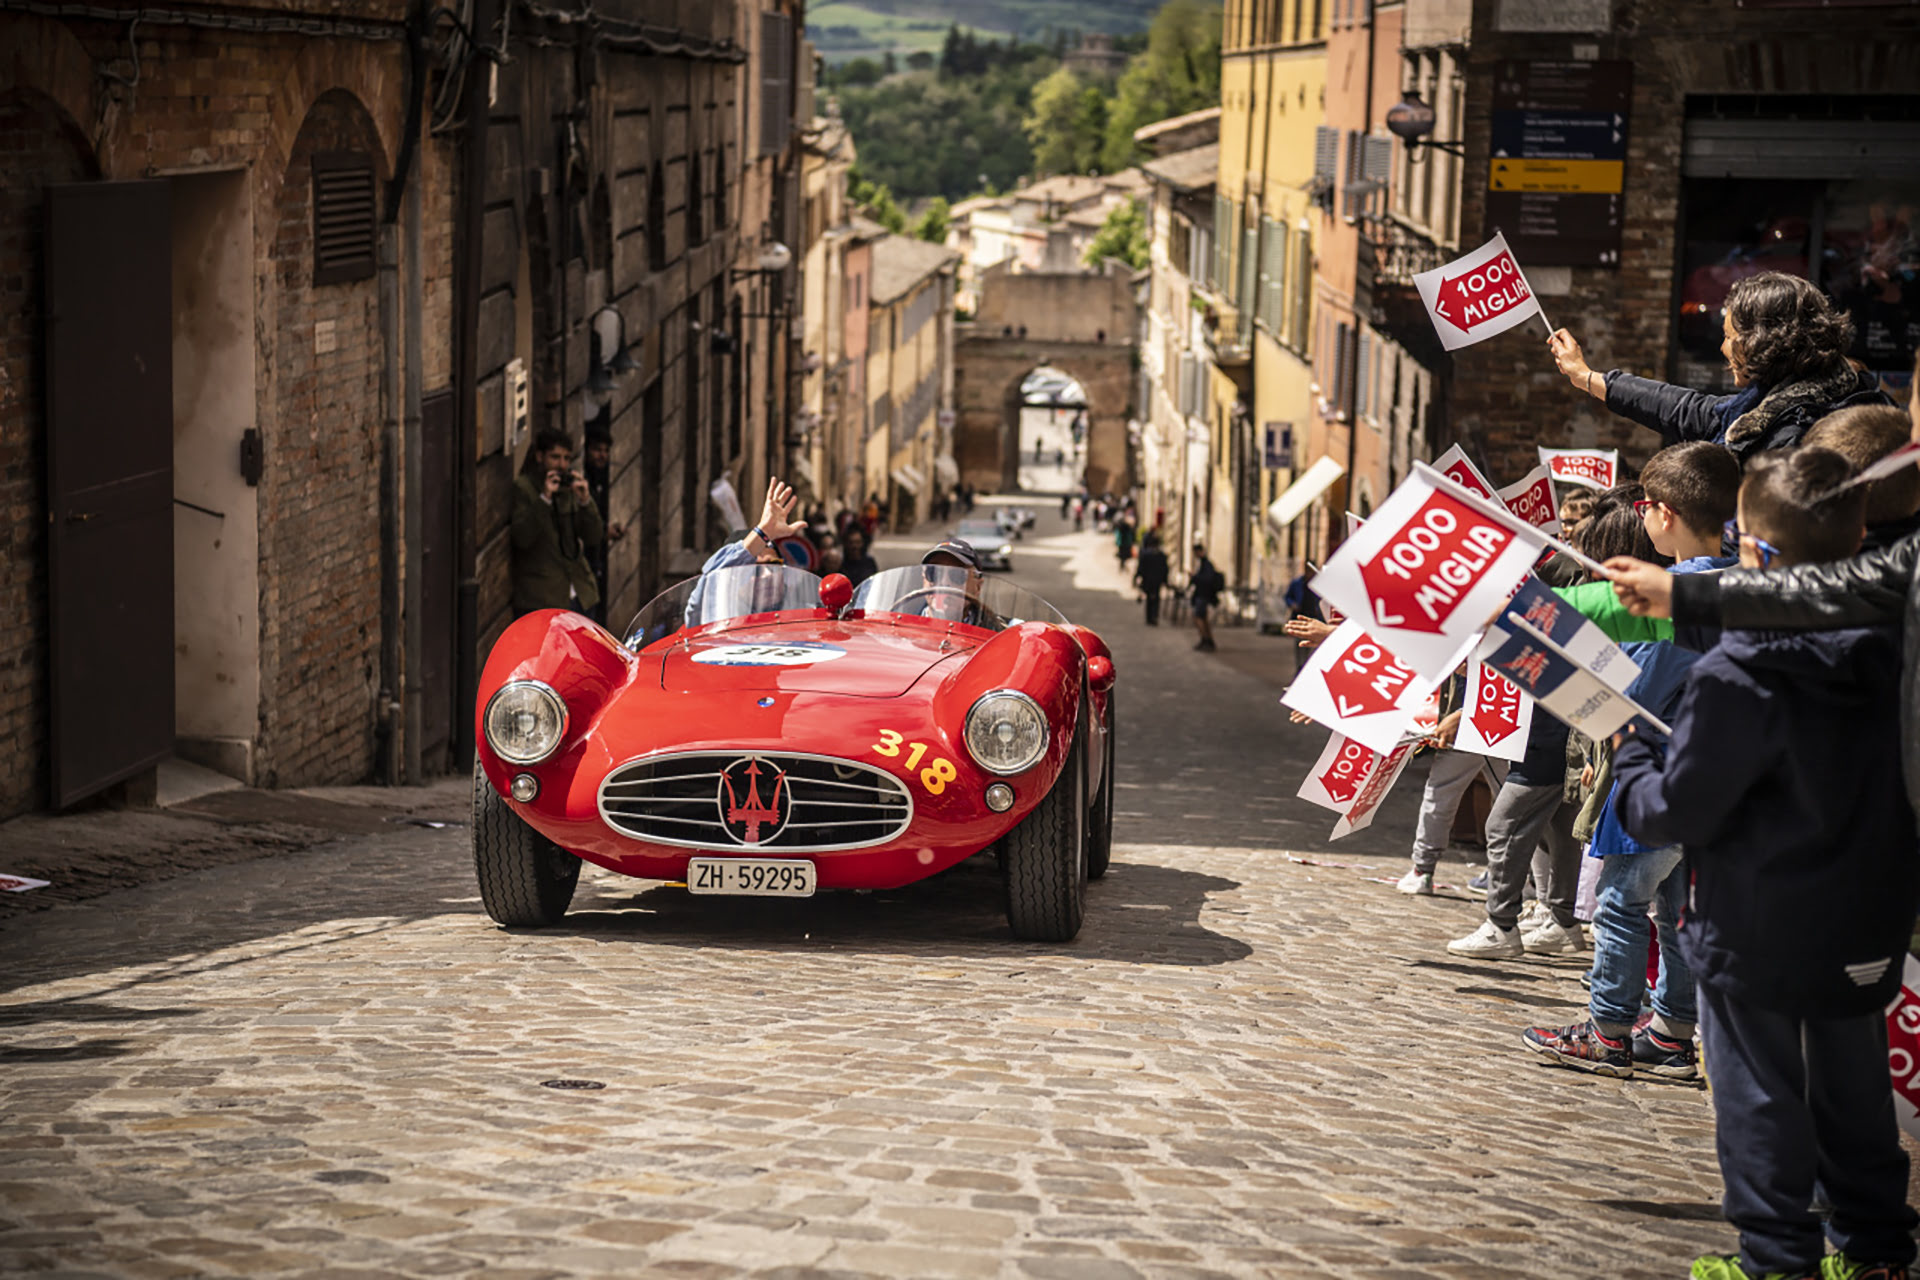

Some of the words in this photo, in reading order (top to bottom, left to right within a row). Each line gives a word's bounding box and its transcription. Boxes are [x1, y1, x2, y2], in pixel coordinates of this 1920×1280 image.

[1457, 257, 1513, 298] 1000
[1463, 278, 1529, 325] MIGLIA
[1561, 465, 1610, 486] MIGLIA
[1563, 457, 1608, 472] 1000
[1511, 485, 1543, 517] 1000
[1382, 507, 1458, 580] 1000
[1414, 525, 1506, 621] MIGLIA
[1500, 679, 1518, 724] MIG
[871, 728, 957, 796] 318
[1332, 744, 1361, 780] 100
